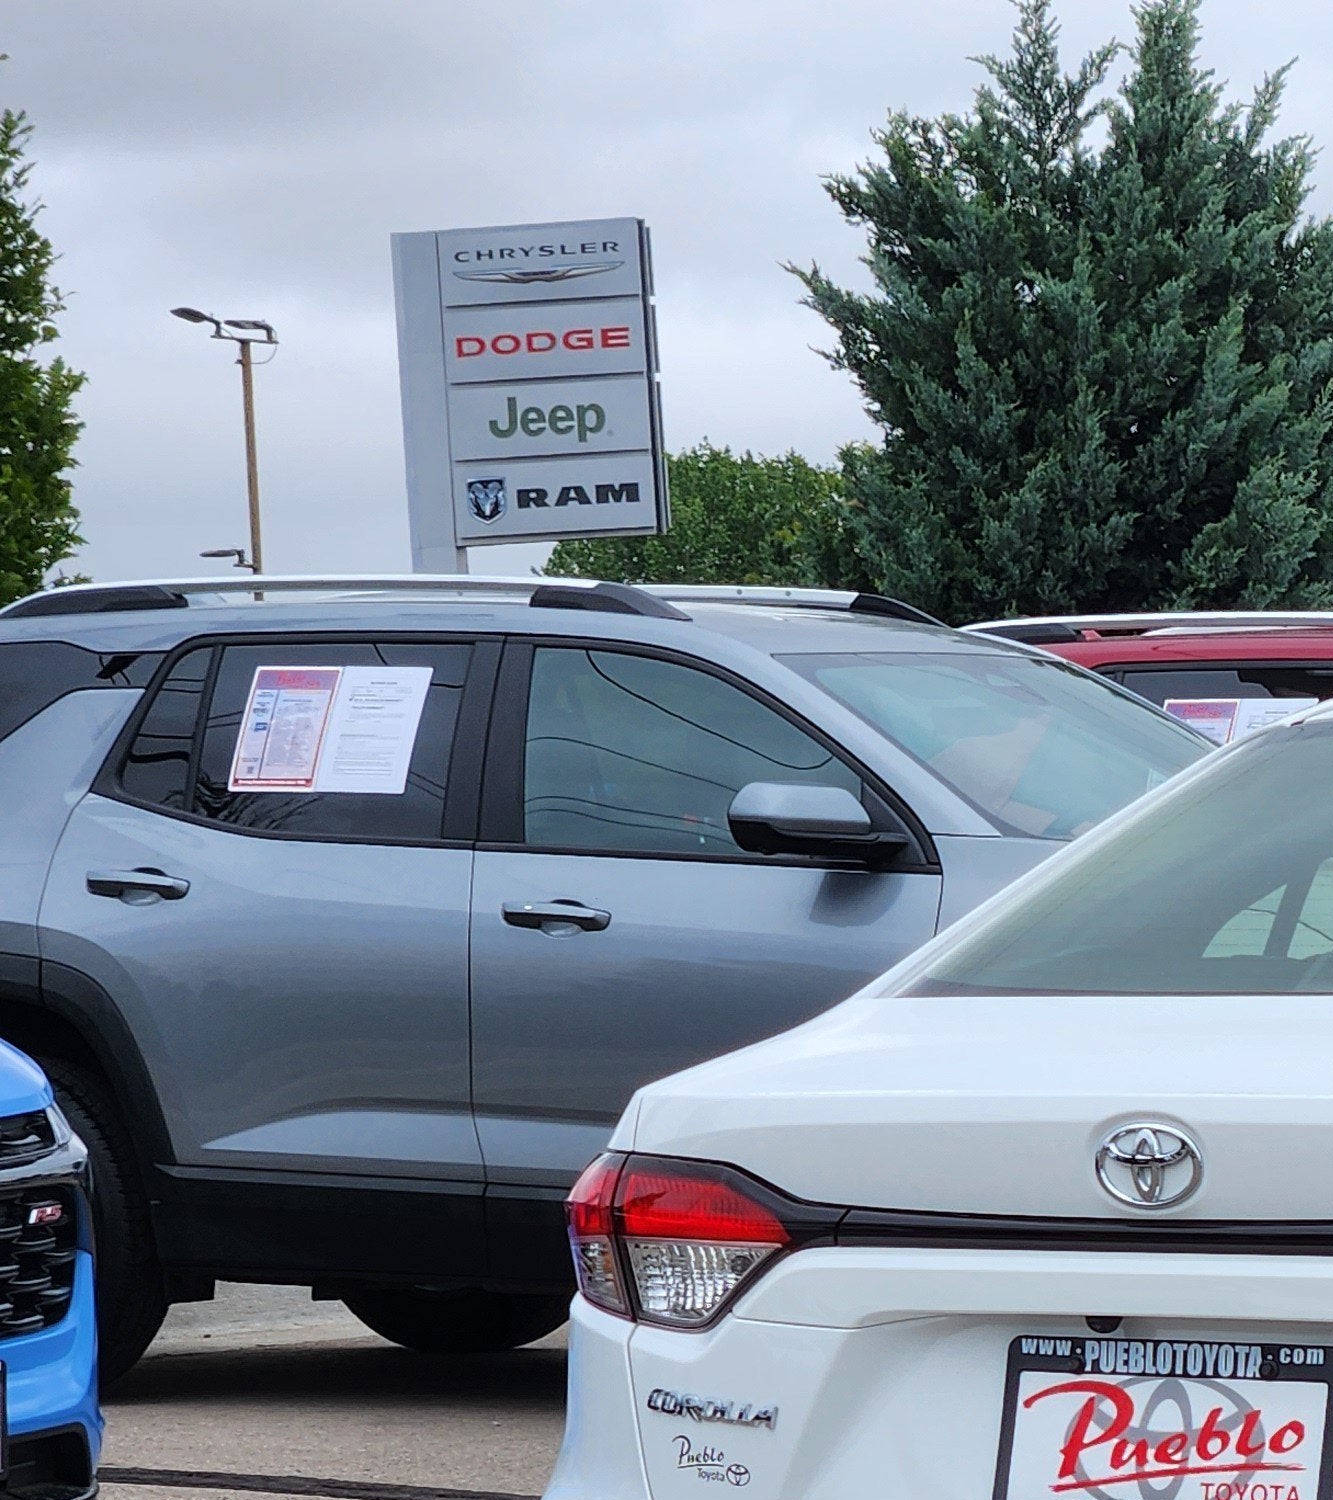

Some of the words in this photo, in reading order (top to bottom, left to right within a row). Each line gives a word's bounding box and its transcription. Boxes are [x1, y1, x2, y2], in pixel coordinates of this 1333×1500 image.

[454, 240, 620, 263] CHRYSLER
[455, 326, 631, 358] DODGE
[488, 397, 606, 443] Jeep
[516, 482, 641, 509] RAM
[1023, 1380, 1306, 1479] Pueblo
[672, 1435, 724, 1465] Pueblo
[697, 1467, 725, 1483] Toyota
